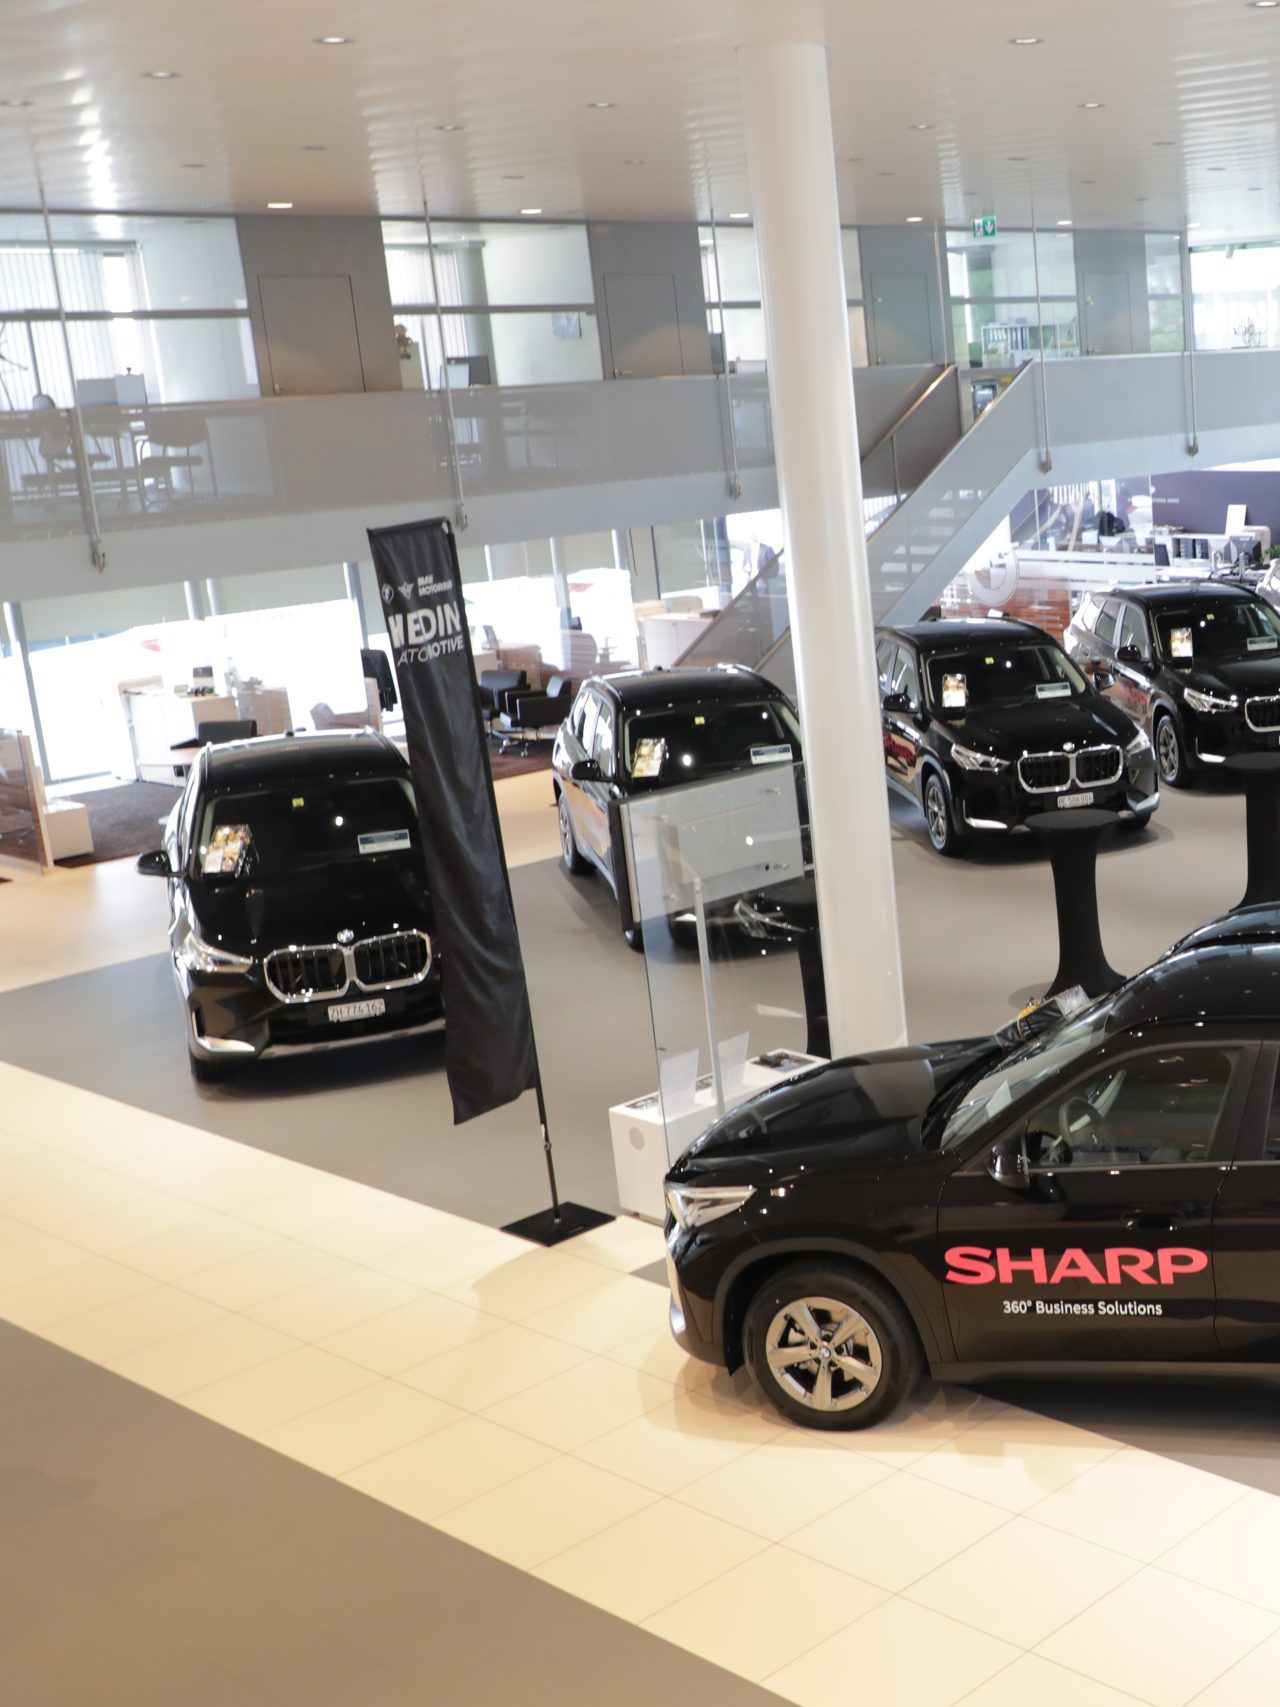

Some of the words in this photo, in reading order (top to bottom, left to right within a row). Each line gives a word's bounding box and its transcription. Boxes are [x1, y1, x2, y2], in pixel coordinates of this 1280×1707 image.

[944, 1246, 1208, 1285] SHARP
[1036, 1301, 1095, 1315] Business
[1098, 1301, 1163, 1315] Solutions
